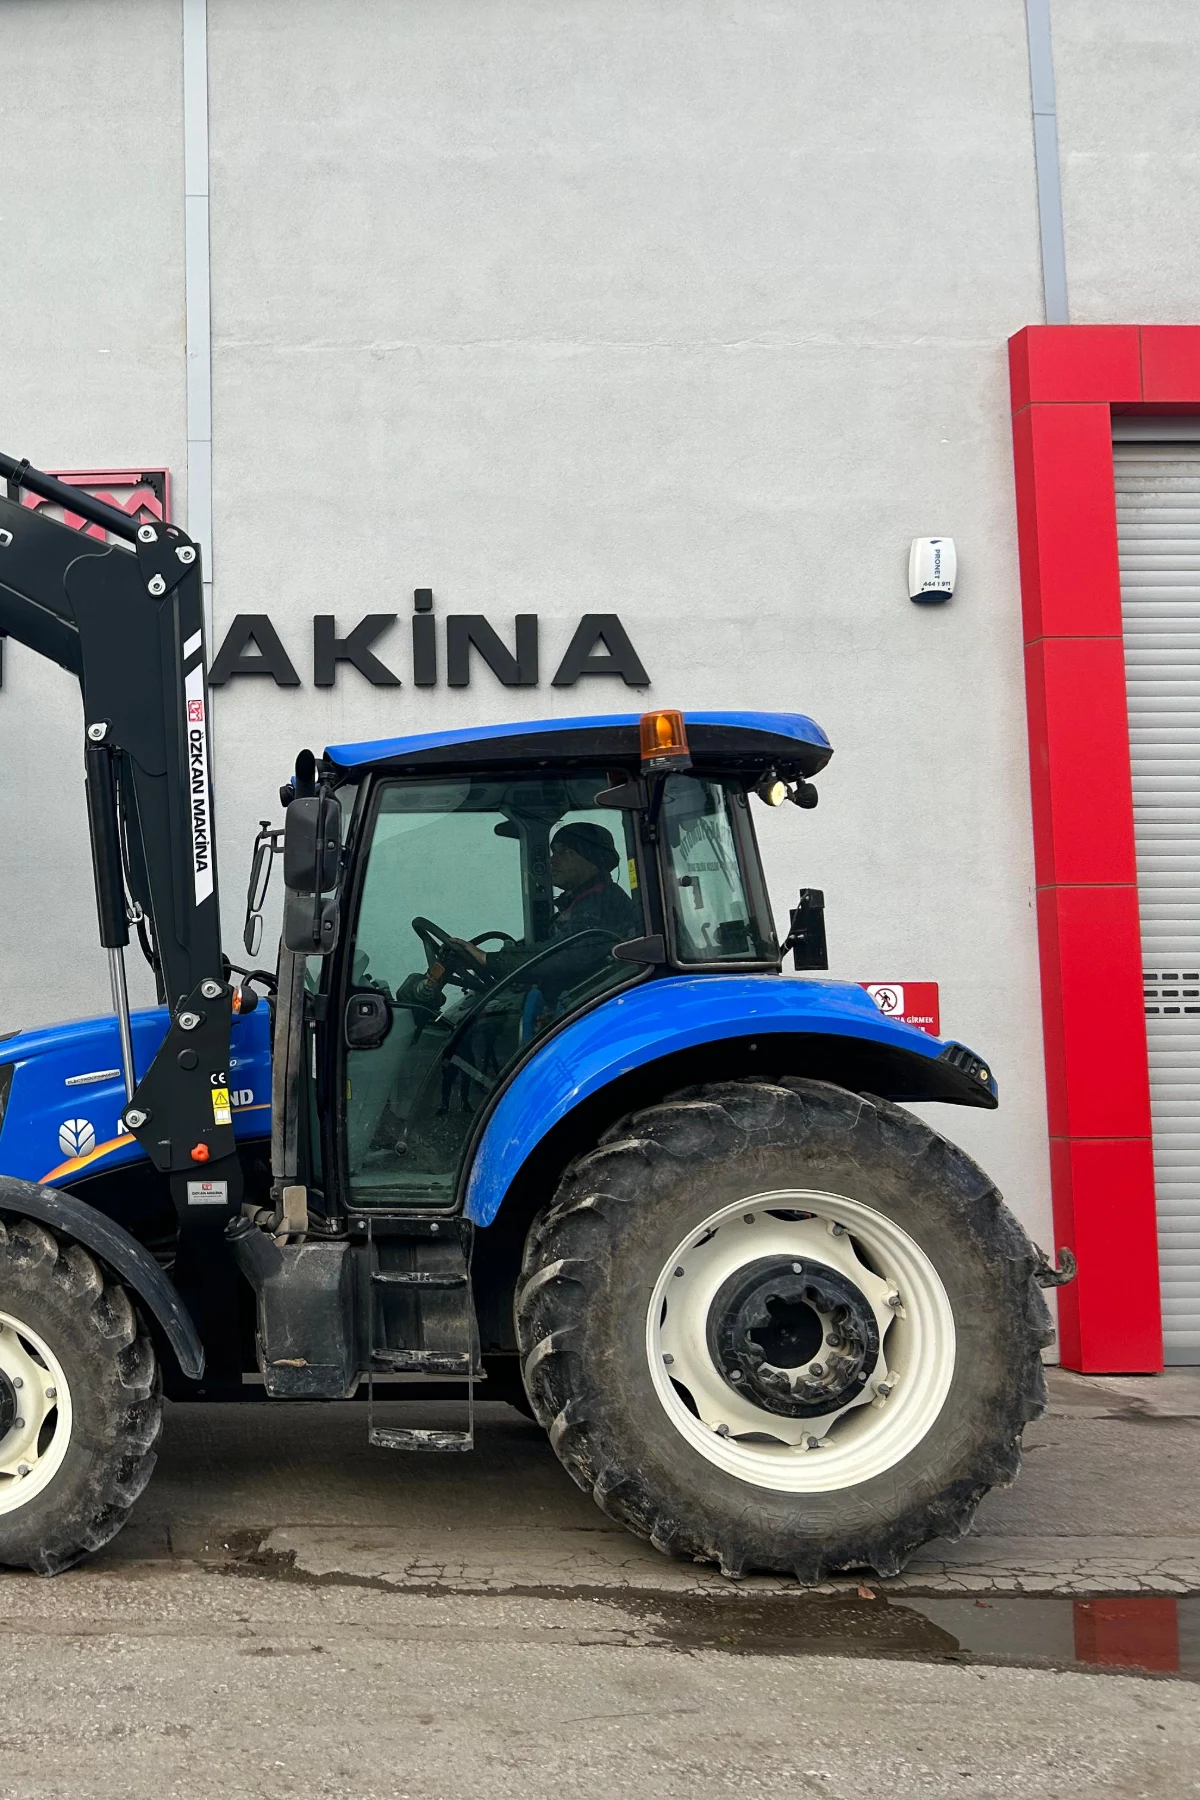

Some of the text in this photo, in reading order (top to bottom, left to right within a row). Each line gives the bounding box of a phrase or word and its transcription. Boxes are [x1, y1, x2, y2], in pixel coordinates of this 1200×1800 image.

[207, 588, 652, 687] AKİNA
[189, 729, 210, 873] ÖZKAN MAKİNA
[906, 1015, 934, 1024] GİRMEK
